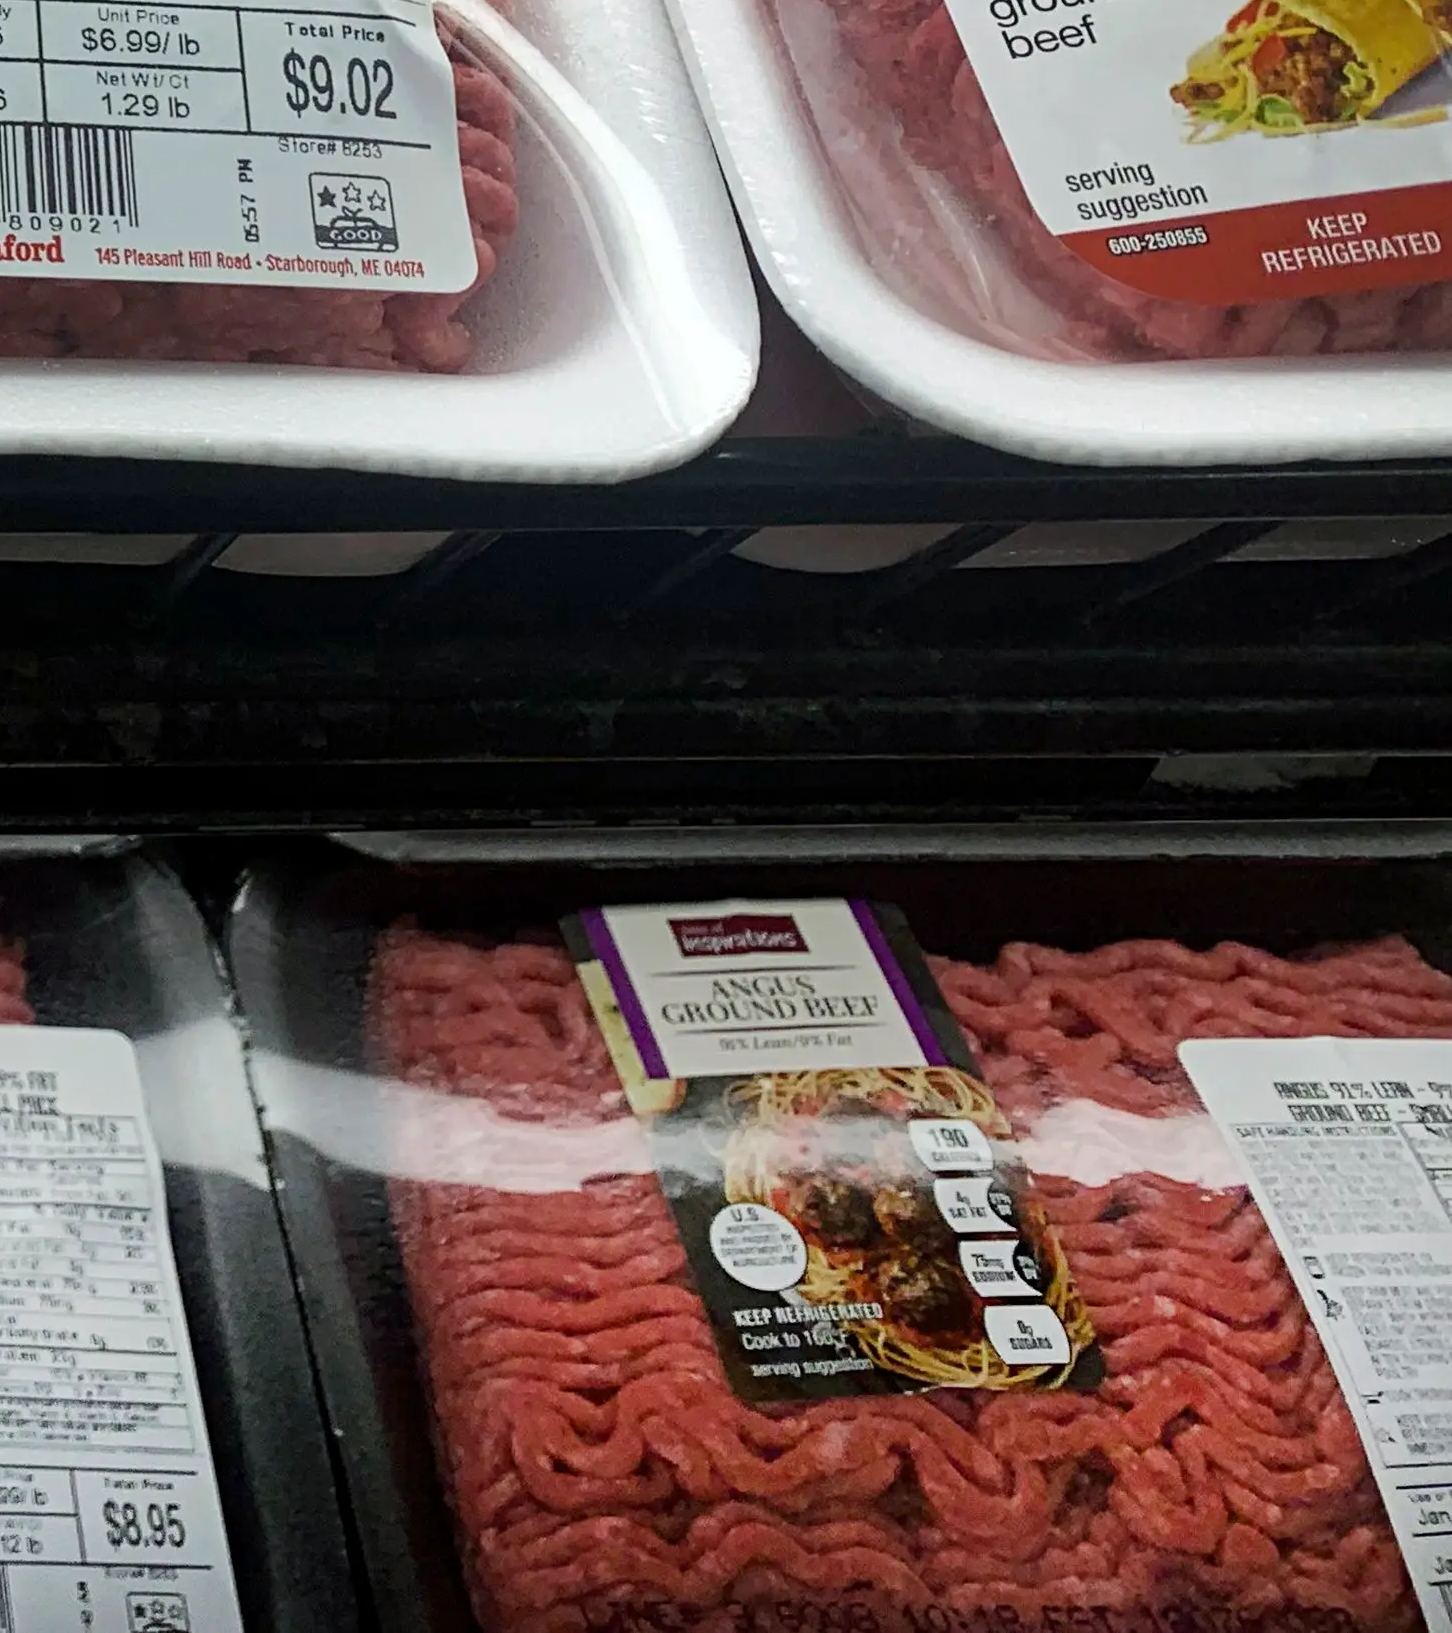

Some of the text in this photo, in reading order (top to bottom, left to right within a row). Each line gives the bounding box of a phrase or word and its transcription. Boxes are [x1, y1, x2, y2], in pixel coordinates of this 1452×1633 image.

[98, 8, 180, 27] Unit Price
[285, 21, 385, 43] Total Price
[81, 27, 201, 56] $6.99/ lb
[1000, 16, 1099, 60] beef
[283, 48, 397, 121] $9.02
[101, 94, 191, 119] 1.29 lb
[1065, 161, 1156, 194] serving
[1077, 181, 1208, 221] suggestion
[1107, 225, 1208, 257] 600-250855
[1307, 211, 1368, 240] KEEP
[96, 248, 121, 266] 145
[123, 248, 183, 269] Pleasant
[187, 250, 213, 269] Hill
[217, 251, 252, 271] Road
[266, 254, 358, 278] Scarborough,
[361, 258, 380, 276] ME
[383, 260, 425, 279] 04074
[1262, 229, 1442, 274] REFRIGERATED
[712, 975, 816, 999] ANGUS
[662, 995, 878, 1025] GROUND BEEF
[103, 1499, 186, 1551] $8.95
